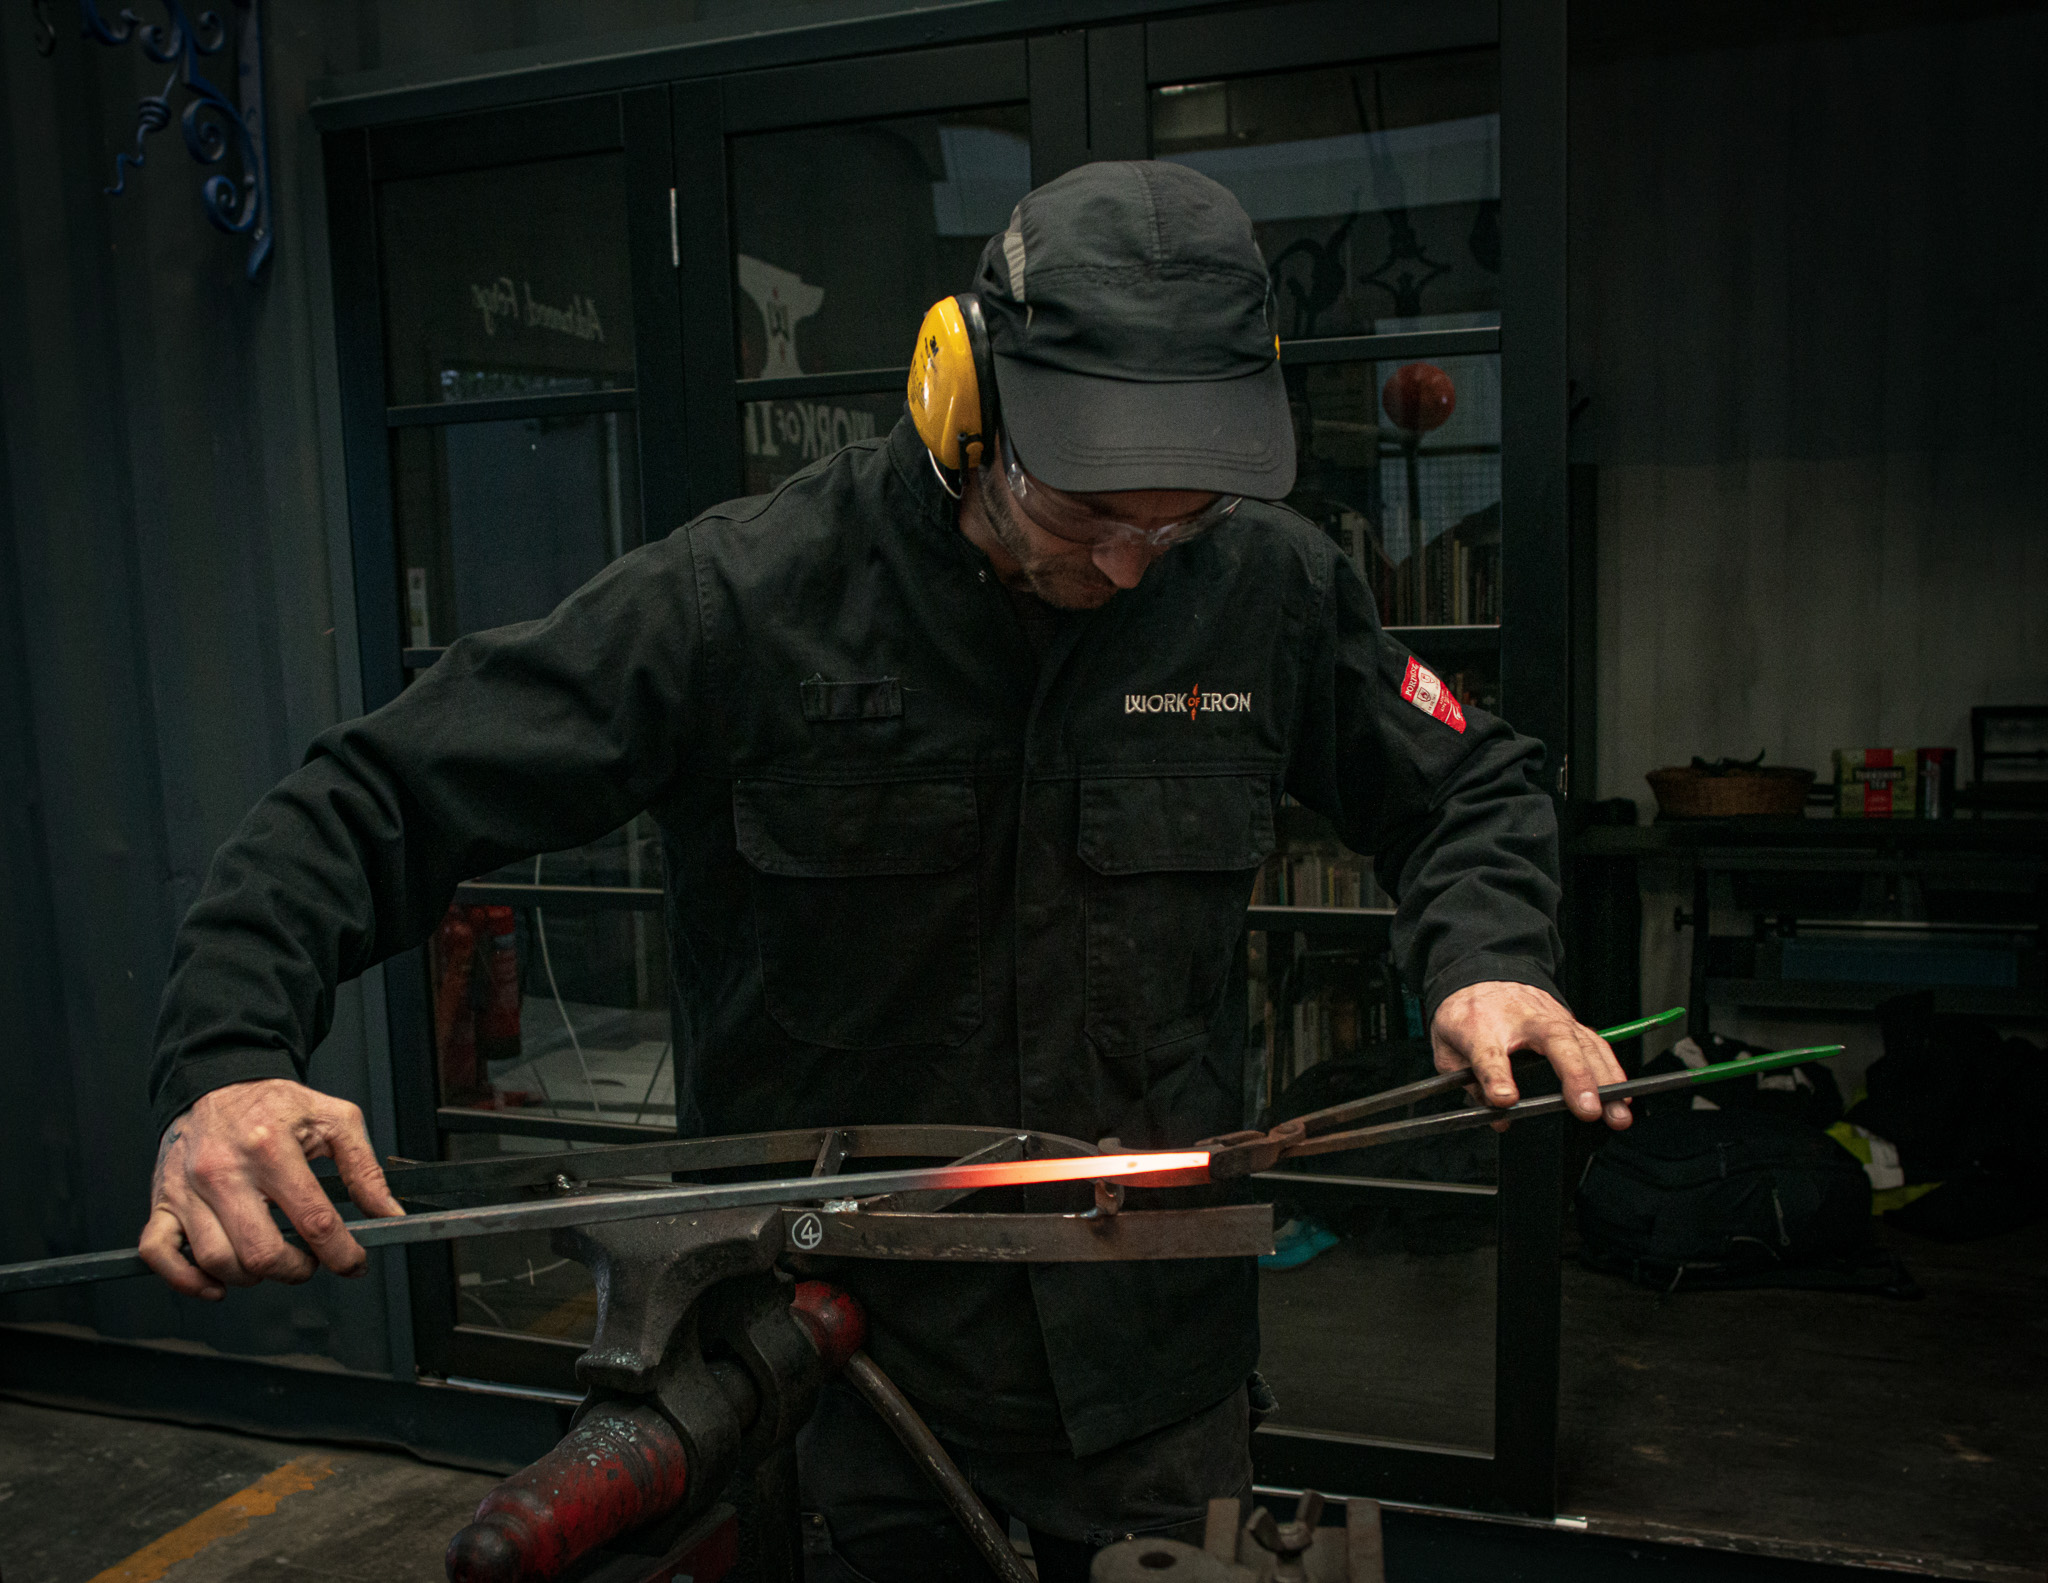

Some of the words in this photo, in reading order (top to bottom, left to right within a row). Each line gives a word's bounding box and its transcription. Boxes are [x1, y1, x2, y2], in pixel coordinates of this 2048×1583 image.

[1124, 693, 1188, 714] WORK
[1187, 696, 1201, 708] OF
[1200, 692, 1252, 713] IRON
[798, 1217, 821, 1247] 4
